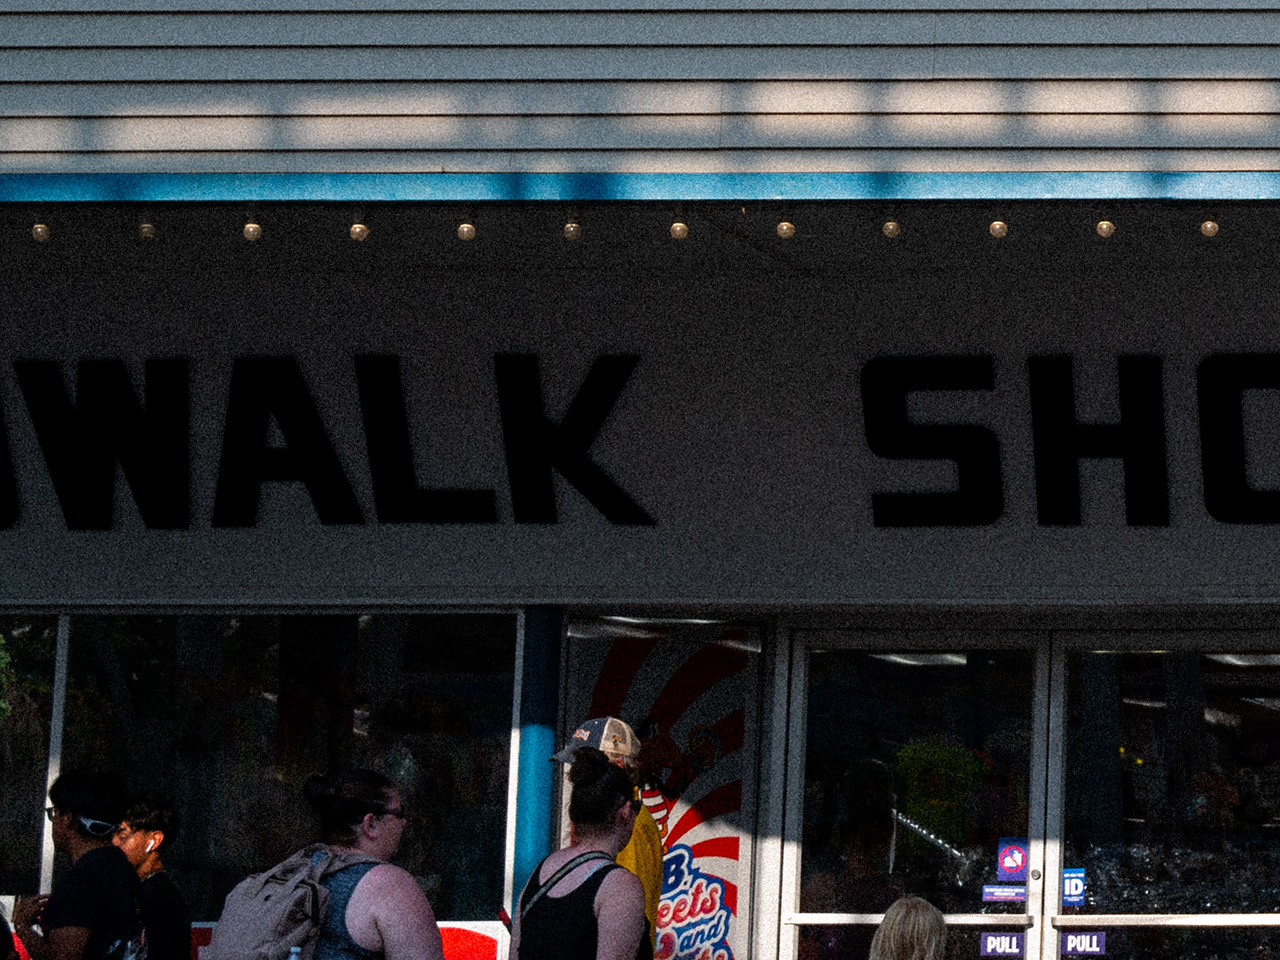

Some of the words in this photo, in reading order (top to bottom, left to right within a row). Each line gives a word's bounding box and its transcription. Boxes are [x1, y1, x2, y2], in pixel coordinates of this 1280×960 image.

[0, 353, 659, 531] WALK
[1064, 878, 1084, 896] ID
[657, 882, 719, 929] eets
[679, 912, 724, 953] and
[986, 935, 1019, 953] PULL
[1067, 934, 1100, 952] PULL
